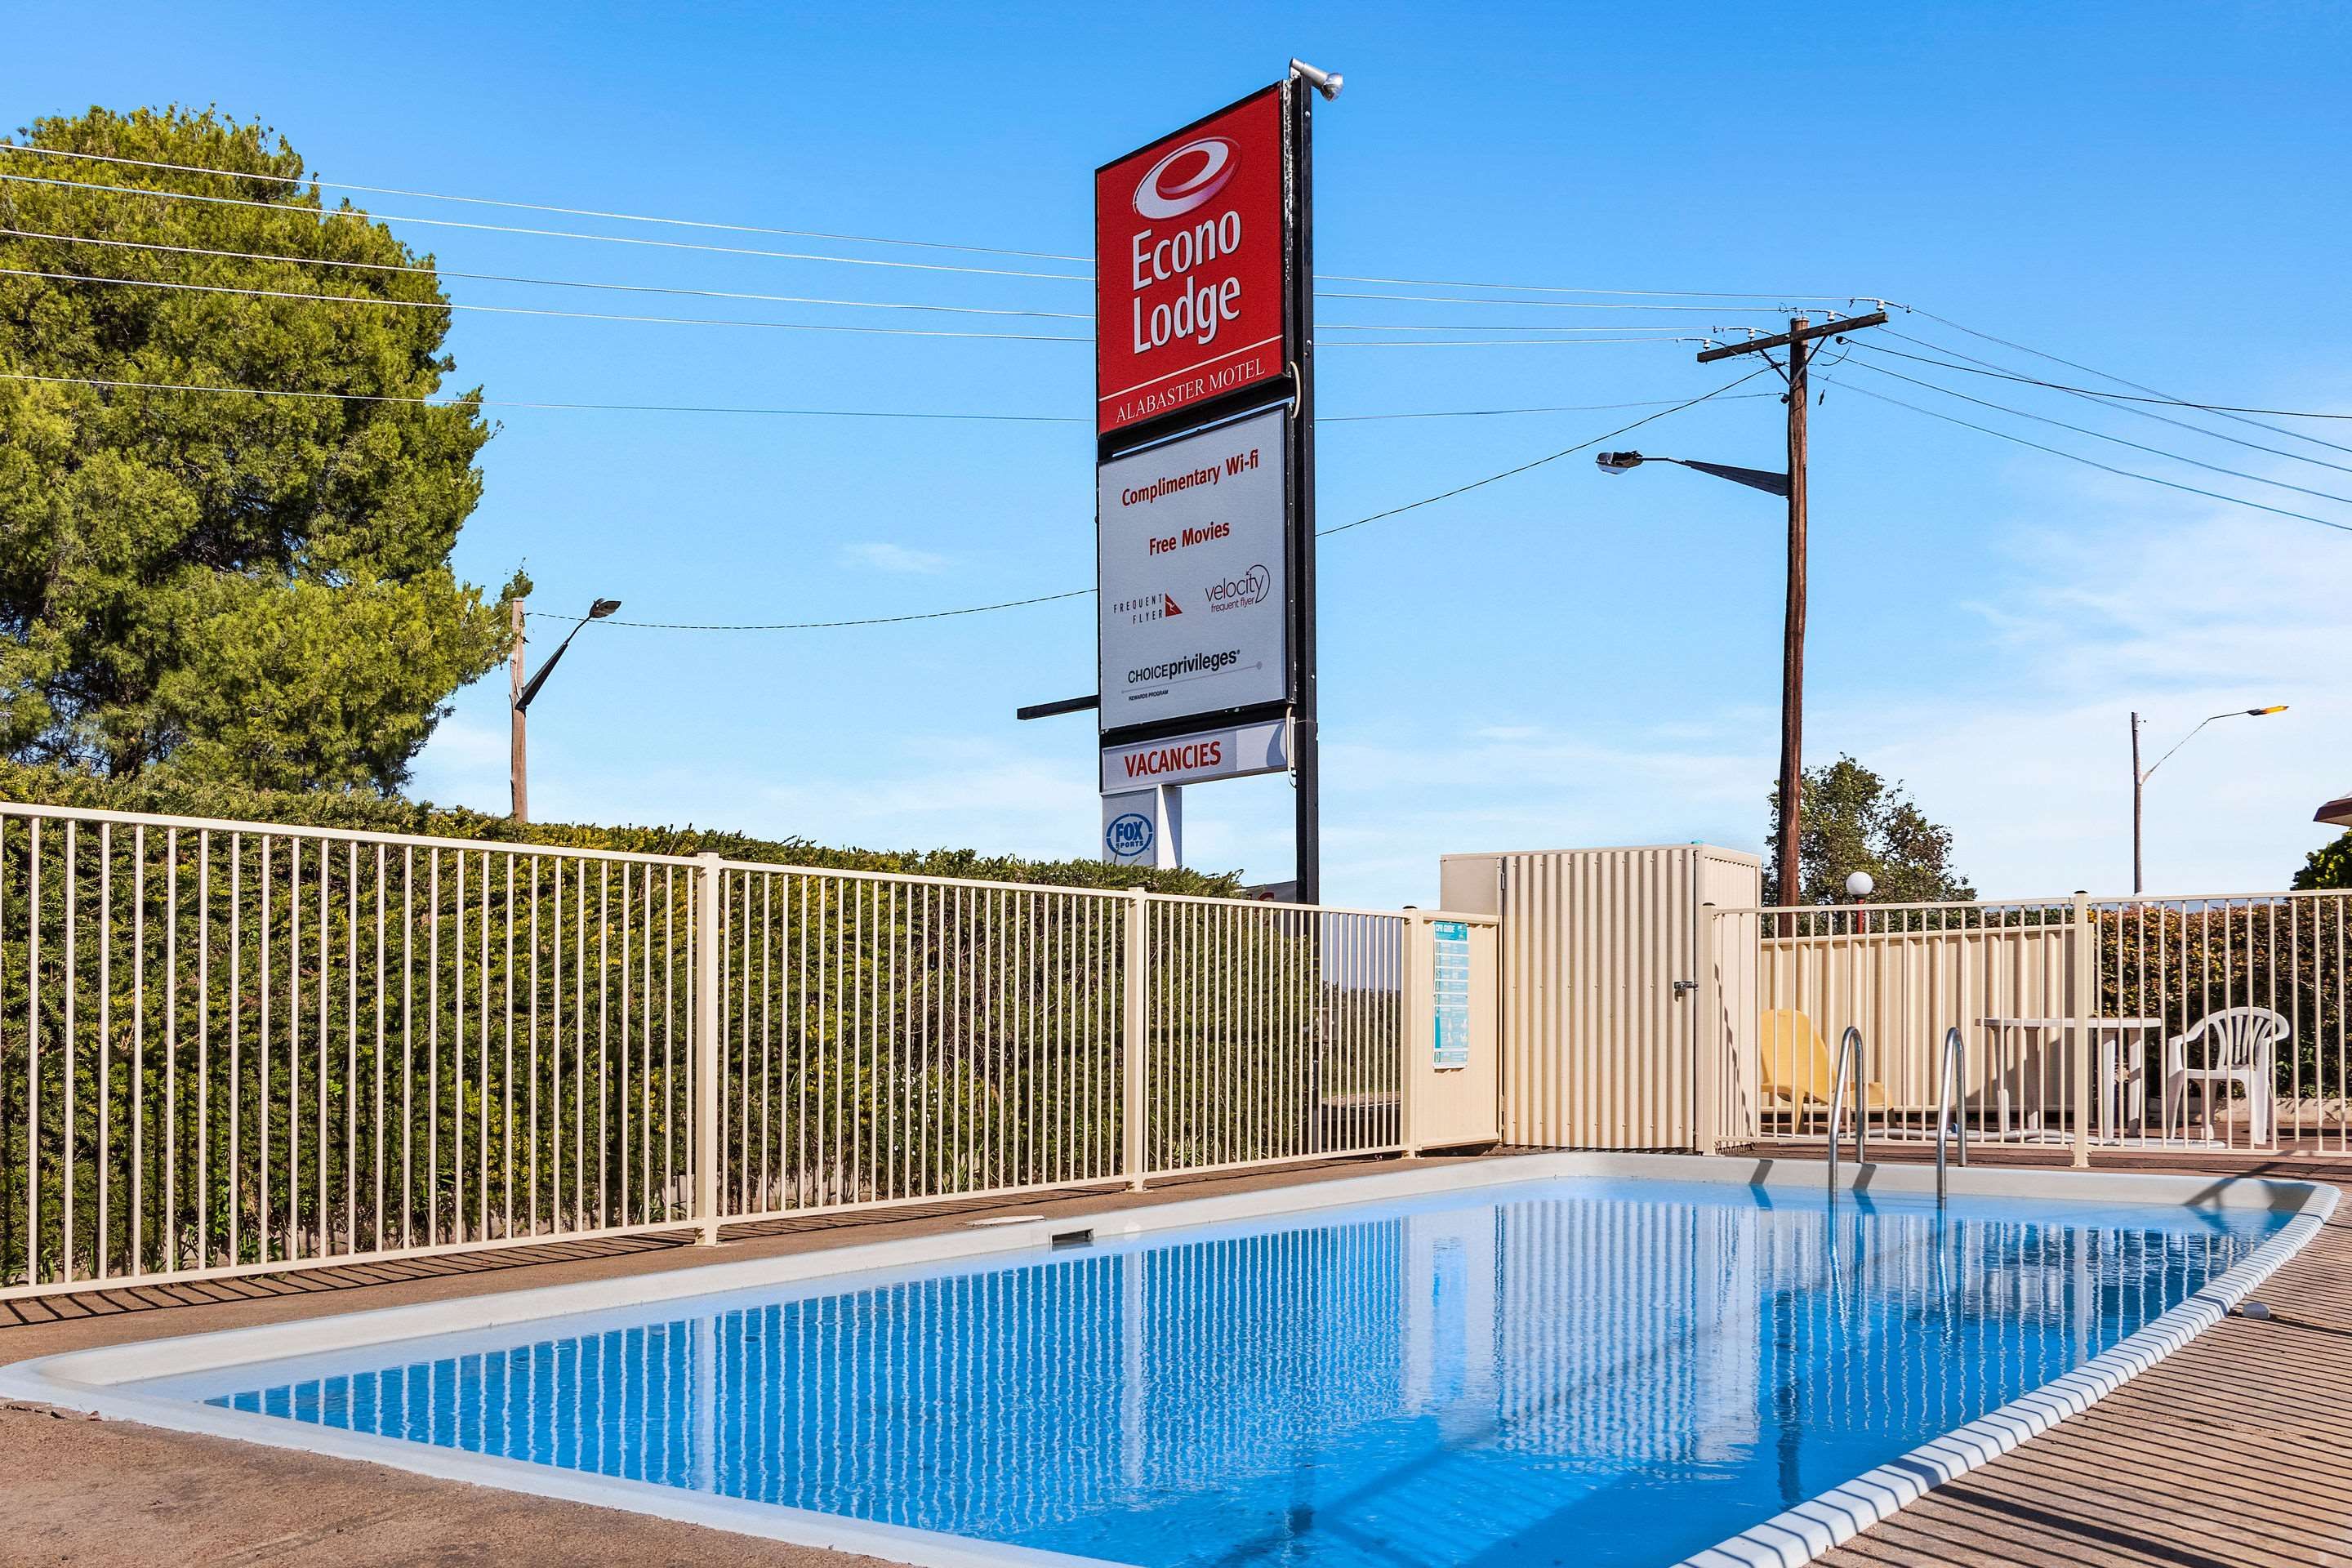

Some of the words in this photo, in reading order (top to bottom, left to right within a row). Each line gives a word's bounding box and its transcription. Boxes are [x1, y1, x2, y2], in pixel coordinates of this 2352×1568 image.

[1133, 210, 1241, 292] Econo
[1134, 275, 1241, 354] Lodge
[1116, 378, 1205, 423] ALABASTER
[1209, 358, 1265, 391] MOTEL
[1122, 466, 1221, 506] Complimentary
[1226, 449, 1258, 476] Wi-fi
[1149, 537, 1176, 556] Free
[1182, 521, 1230, 547] Movies
[1113, 594, 1162, 614] FREQUENT
[1205, 573, 1265, 604] velocity
[1211, 599, 1239, 612] frequent
[1240, 596, 1255, 609] flyer
[1133, 609, 1163, 625] FLYER
[1148, 689, 1169, 698] PROGRAM
[1124, 741, 1222, 778] VACANCIES
[1116, 821, 1144, 842] FOX
[1116, 840, 1144, 849] SPORTS
